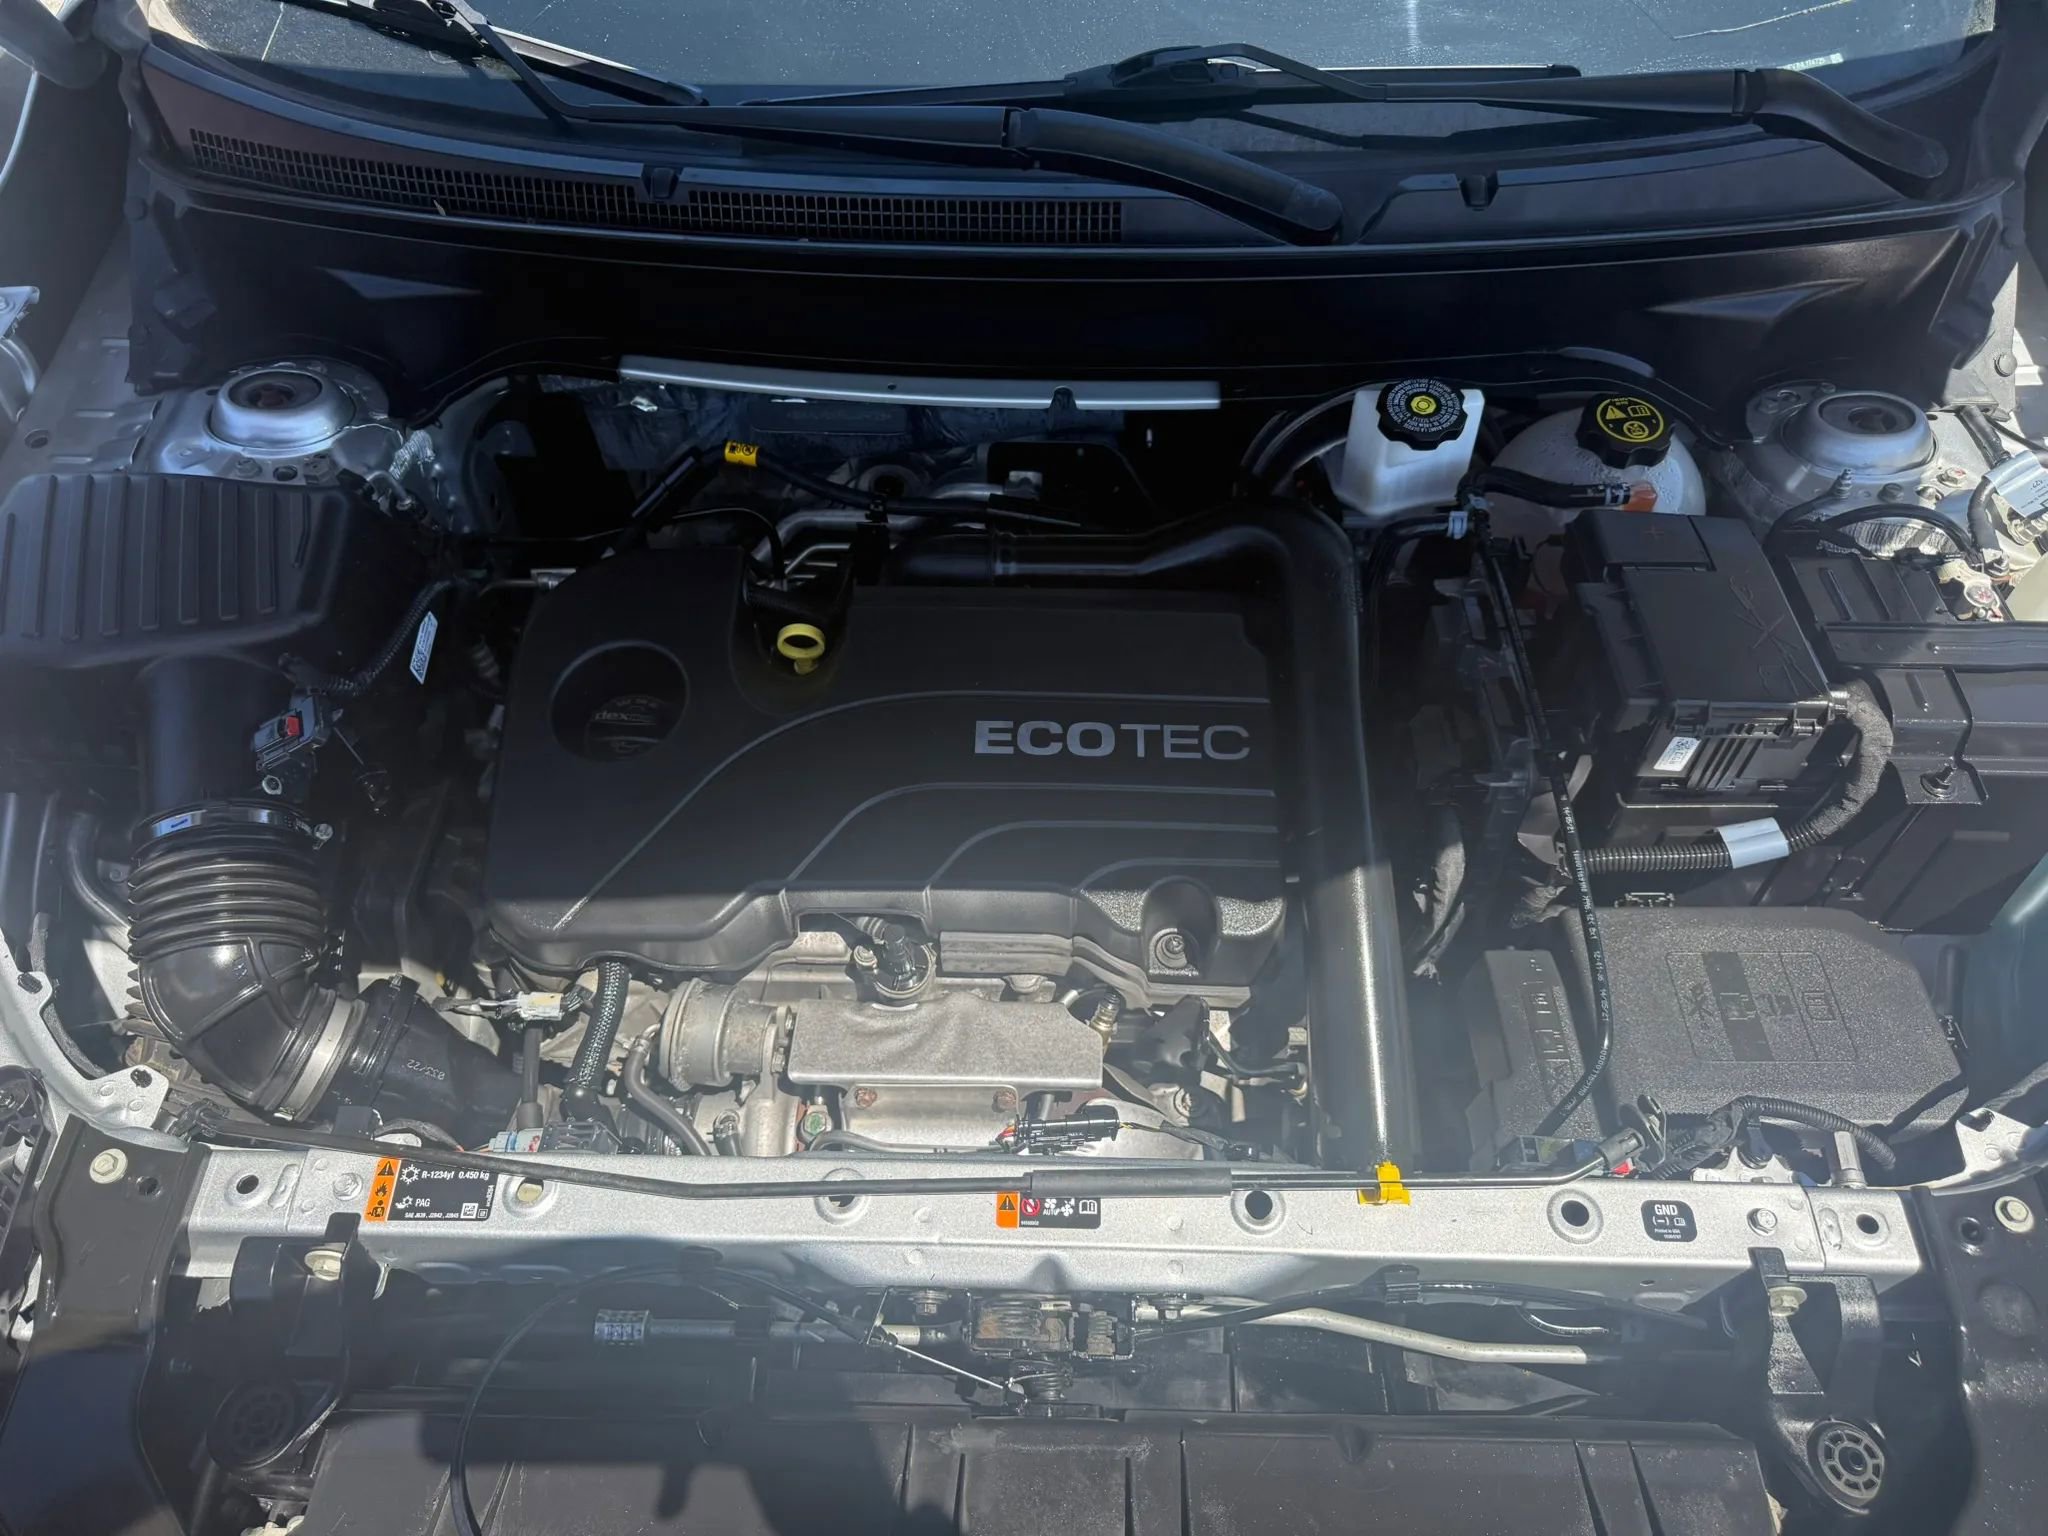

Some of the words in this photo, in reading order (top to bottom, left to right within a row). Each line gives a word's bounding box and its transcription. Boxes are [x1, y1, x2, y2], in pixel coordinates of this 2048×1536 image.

[974, 719, 1251, 761] ECOTEC
[421, 1170, 455, 1181] R-1234yf
[458, 1170, 480, 1179] 0.450
[480, 1171, 490, 1180] kg
[415, 1198, 431, 1207] PAG
[1654, 1204, 1678, 1216] GND
